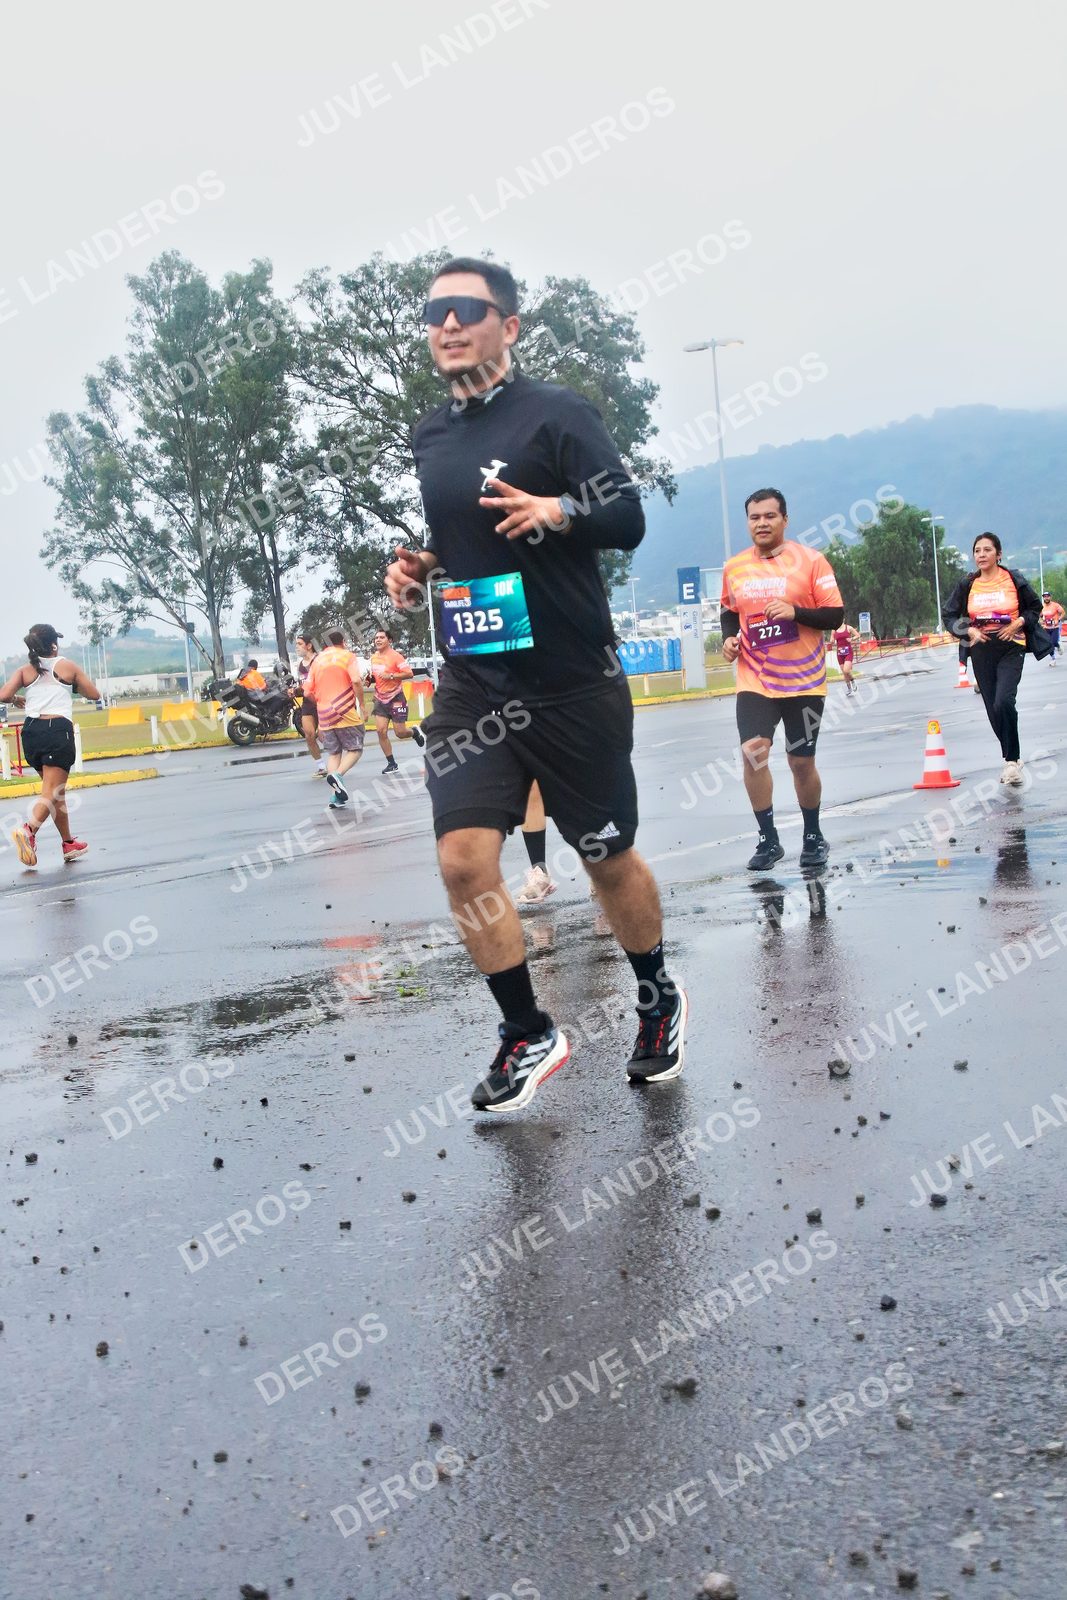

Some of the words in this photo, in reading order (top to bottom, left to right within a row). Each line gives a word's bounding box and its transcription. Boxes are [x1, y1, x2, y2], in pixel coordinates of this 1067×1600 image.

[494, 579, 514, 597] 10K
[682, 583, 695, 600] E
[453, 608, 504, 634] 1325
[758, 625, 783, 639] 272
